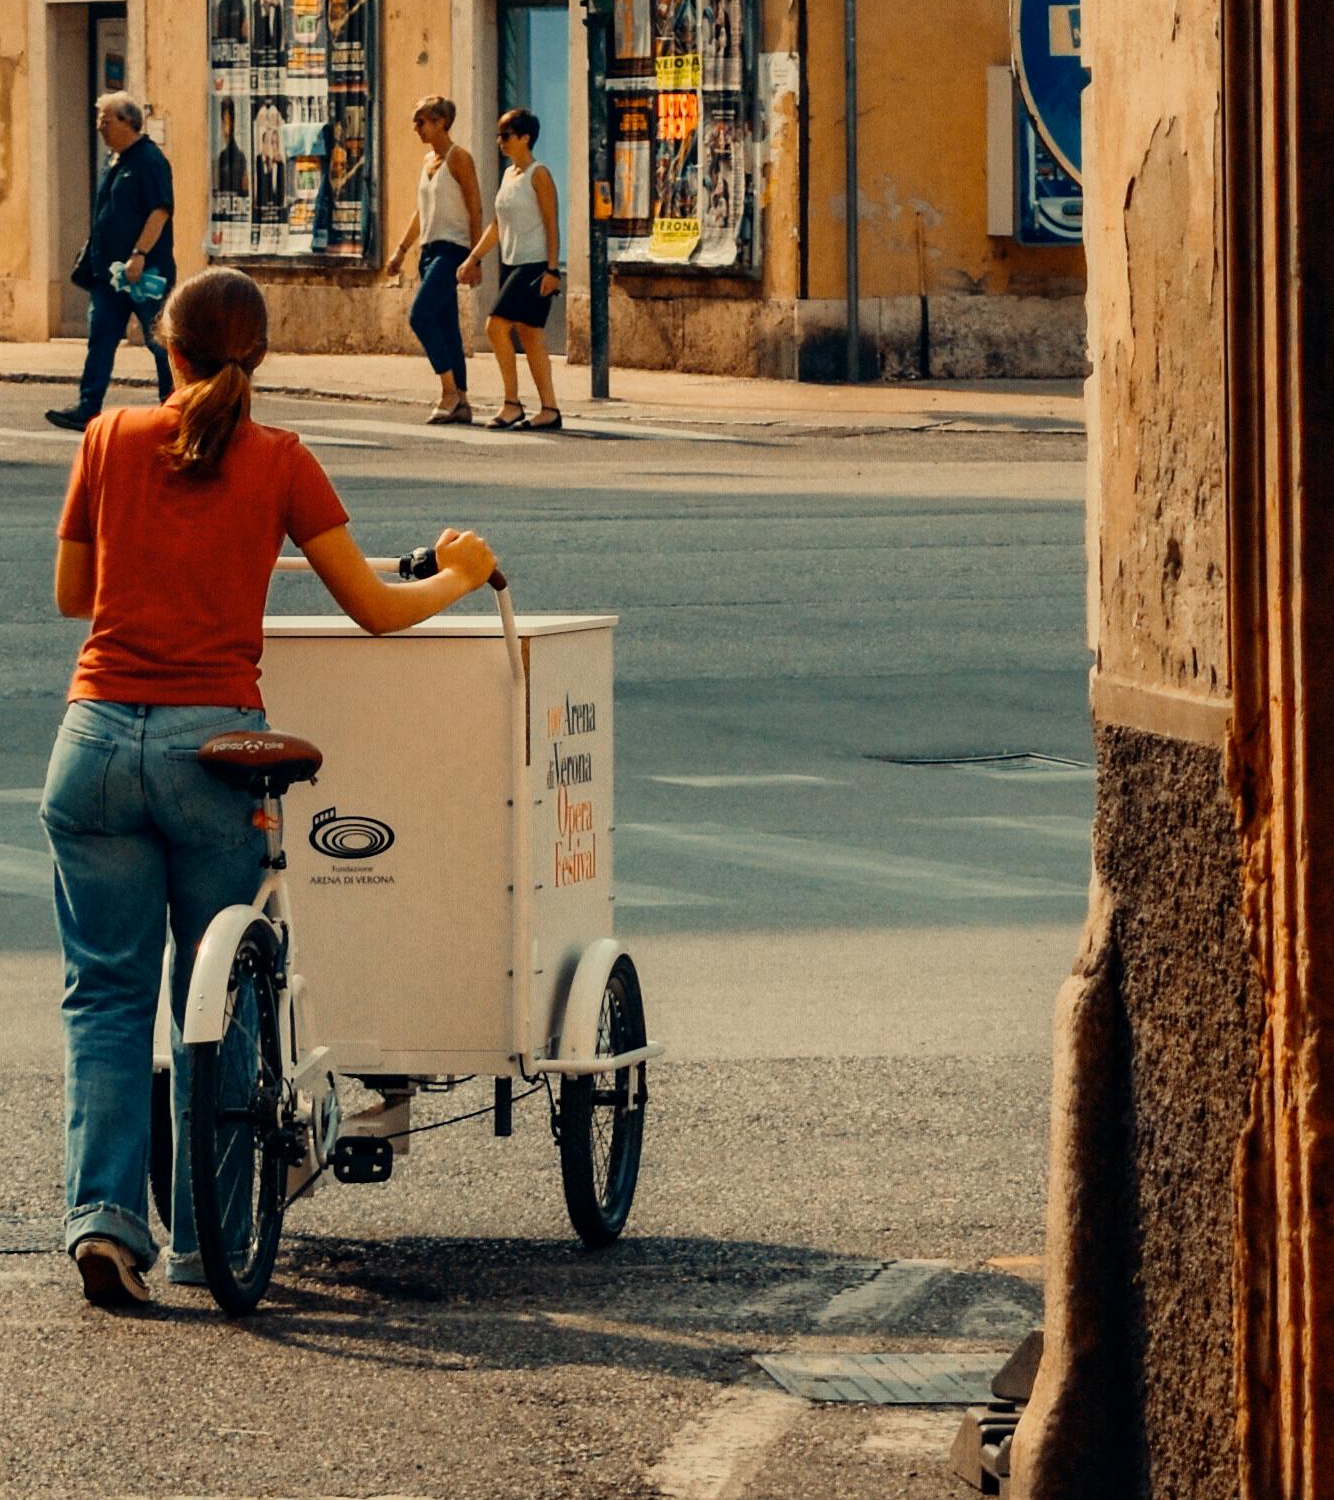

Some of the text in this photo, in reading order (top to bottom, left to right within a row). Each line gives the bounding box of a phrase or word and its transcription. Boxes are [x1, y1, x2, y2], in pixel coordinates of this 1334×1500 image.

[564, 691, 596, 737] Arena
[554, 741, 593, 787] Verona
[557, 784, 593, 852] Opera
[310, 875, 396, 885] ARENA DI VERONA
[554, 832, 597, 888] Festival
